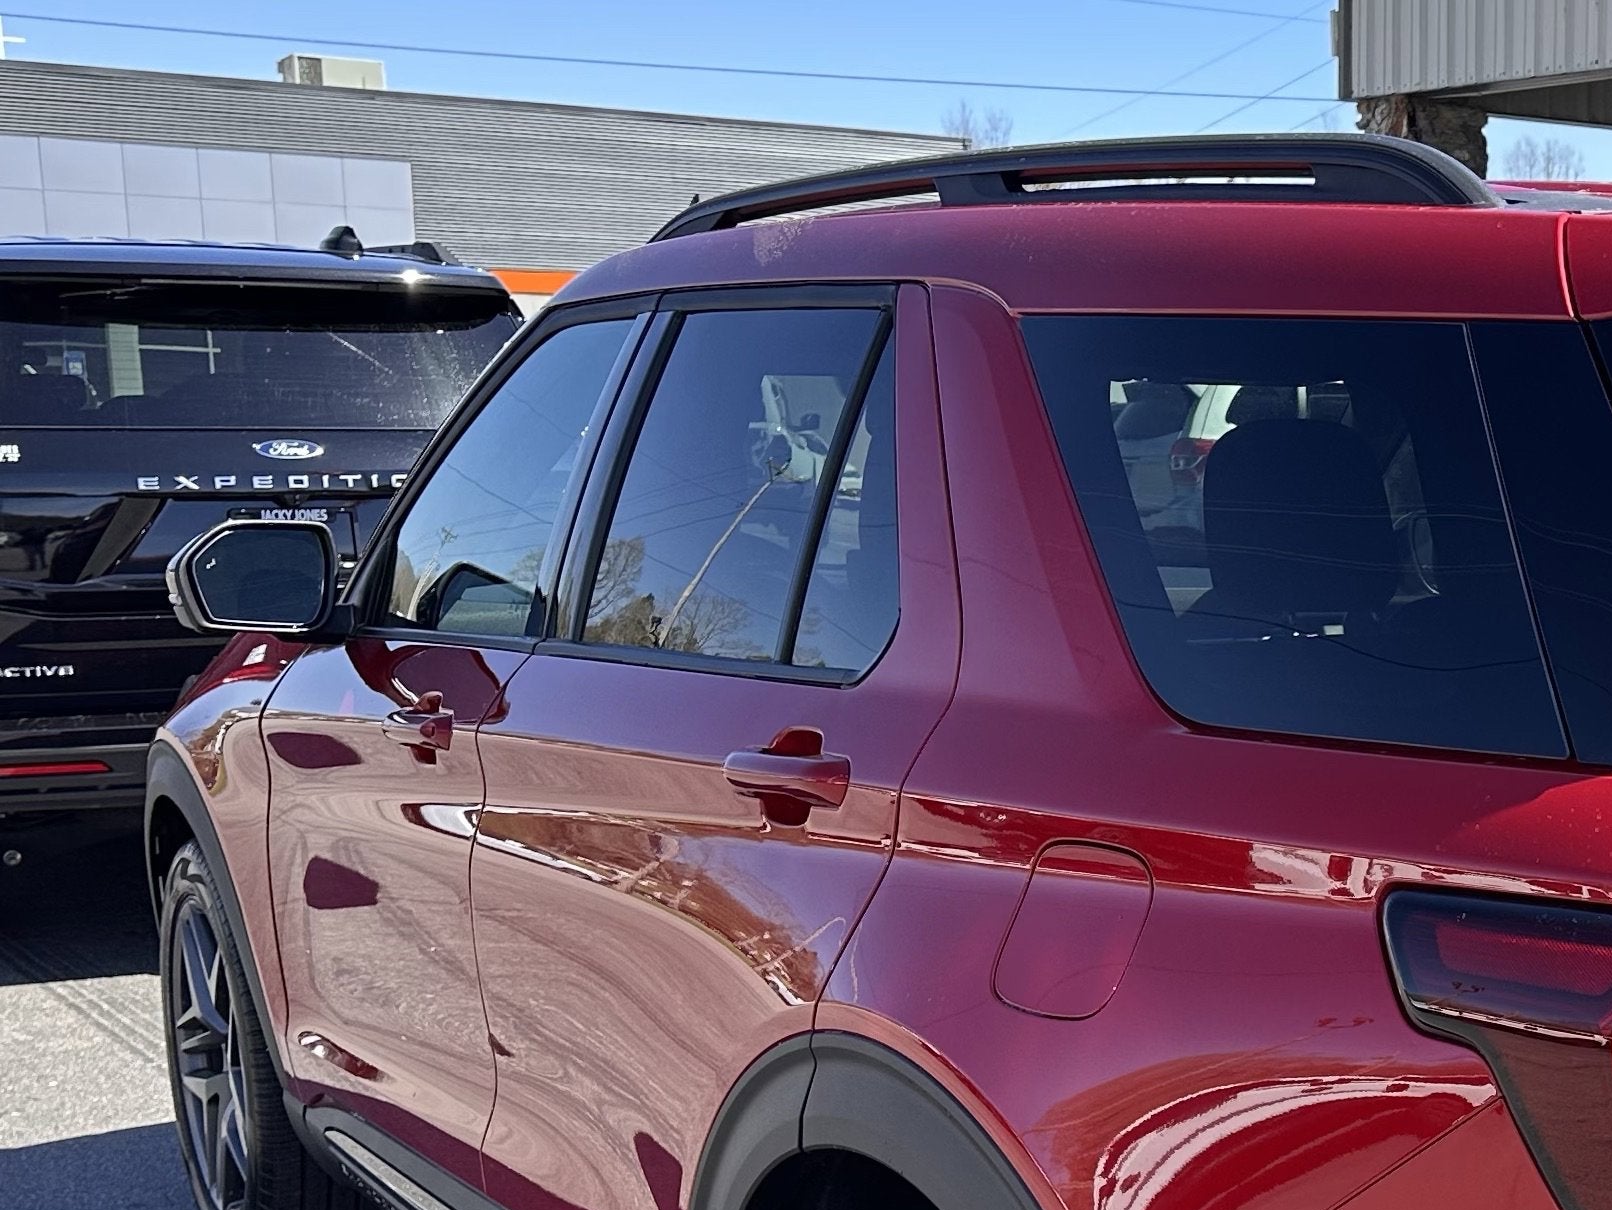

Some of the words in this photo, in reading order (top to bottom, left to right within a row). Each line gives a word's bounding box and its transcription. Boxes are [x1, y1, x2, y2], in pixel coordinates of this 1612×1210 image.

[137, 473, 408, 490] EXPEDITIO
[260, 508, 293, 520] JACKY
[294, 508, 328, 521] JONES
